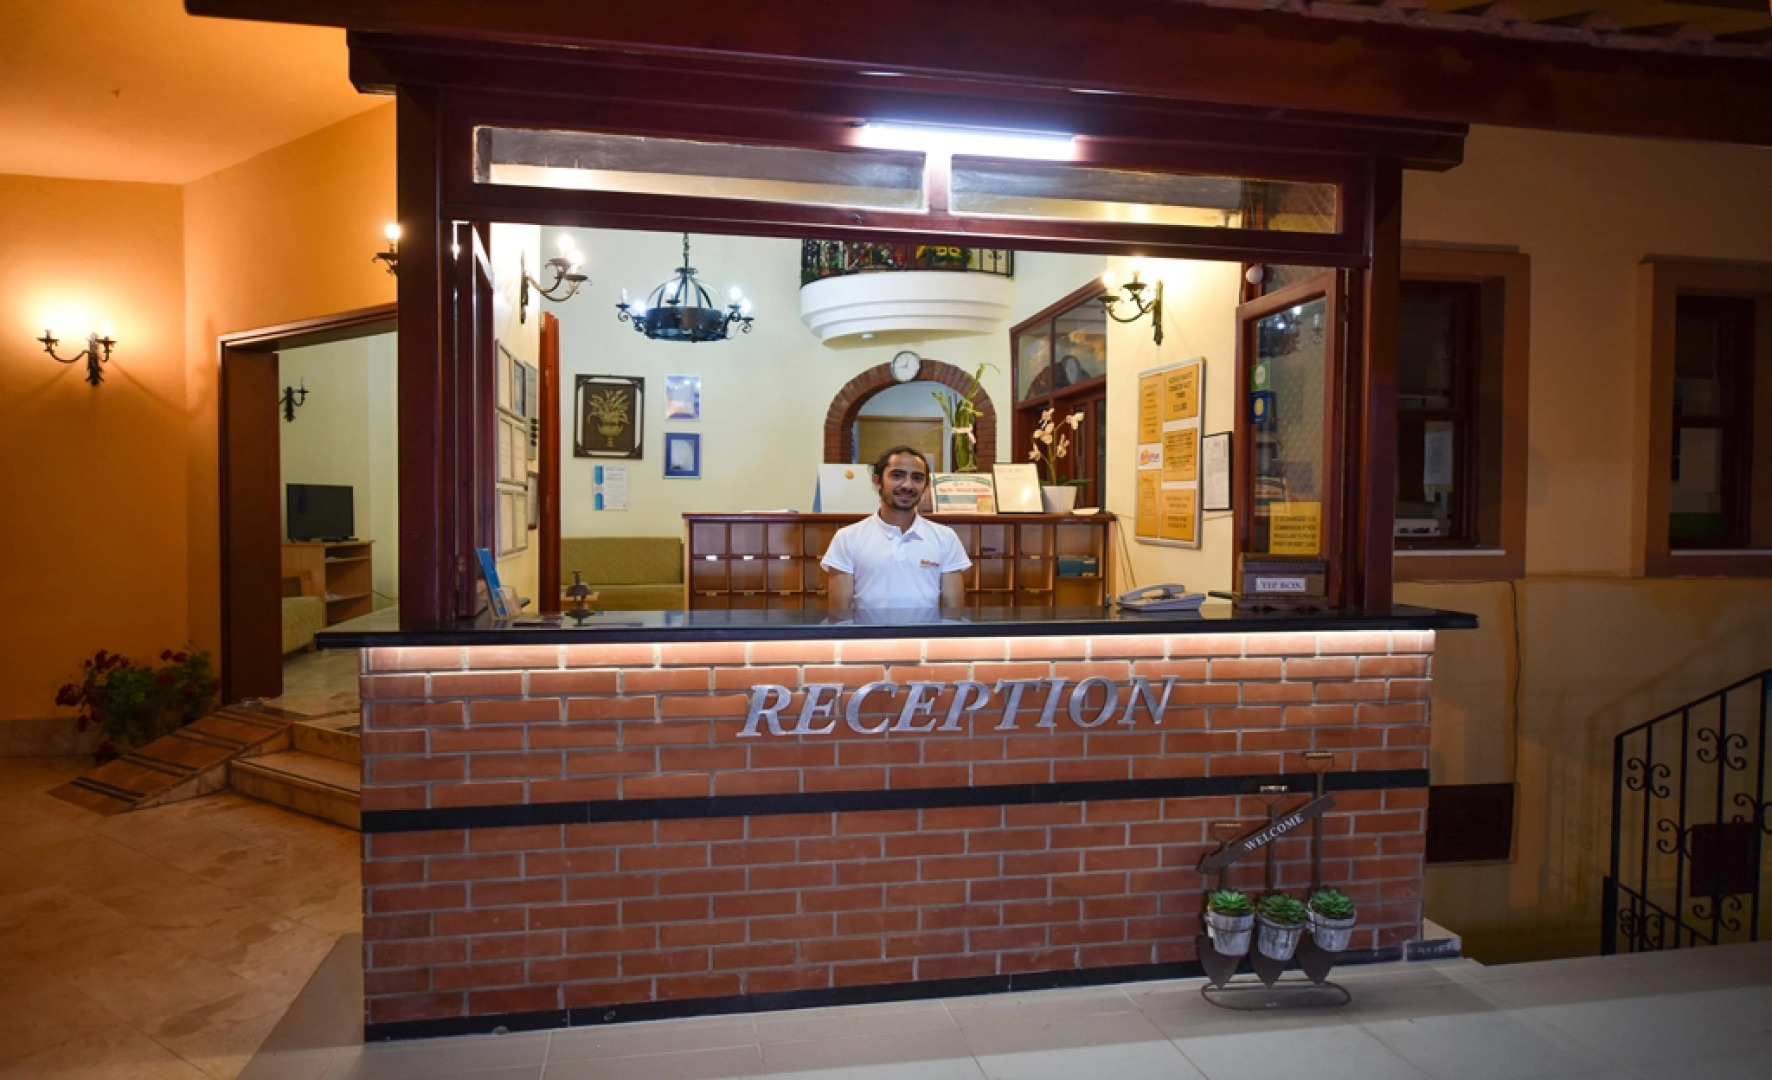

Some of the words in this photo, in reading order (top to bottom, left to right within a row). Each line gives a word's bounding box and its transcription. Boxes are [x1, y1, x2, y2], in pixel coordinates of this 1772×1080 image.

[1261, 581, 1279, 589] TIP
[1280, 581, 1302, 589] BOX
[736, 675, 1180, 738] RECEPTION
[1243, 812, 1304, 851] WELCOME
